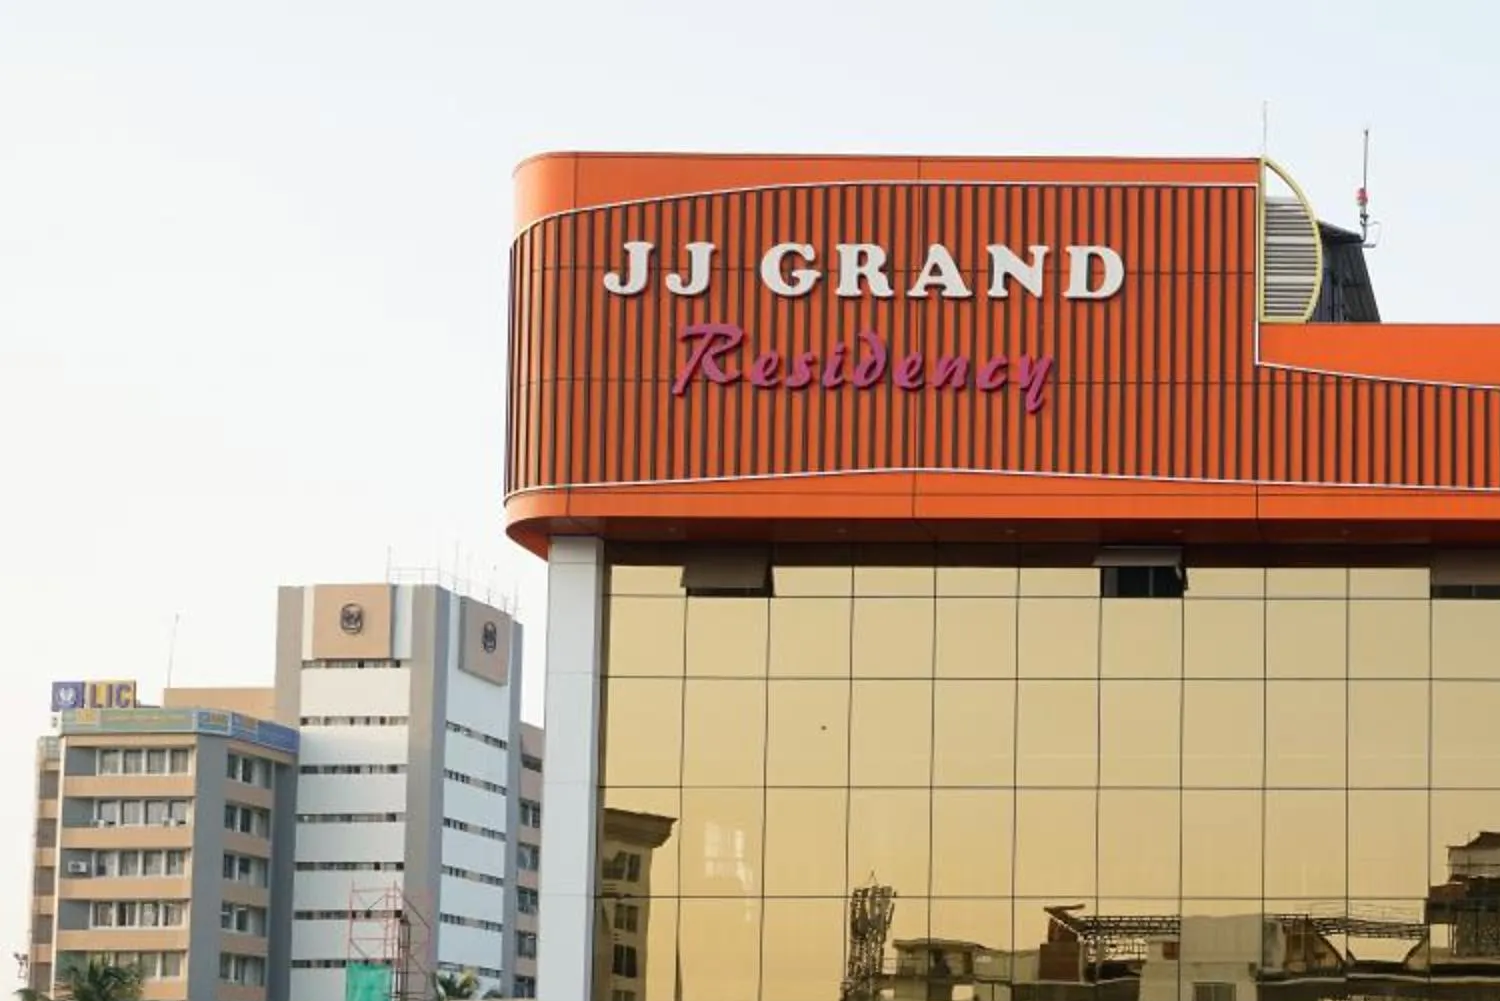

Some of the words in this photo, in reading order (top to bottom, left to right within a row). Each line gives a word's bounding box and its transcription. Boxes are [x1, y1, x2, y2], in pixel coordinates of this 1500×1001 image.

[603, 241, 717, 297] JJ
[760, 242, 1126, 300] GRAND
[671, 322, 1056, 413] Residency
[89, 683, 132, 709] LIC
